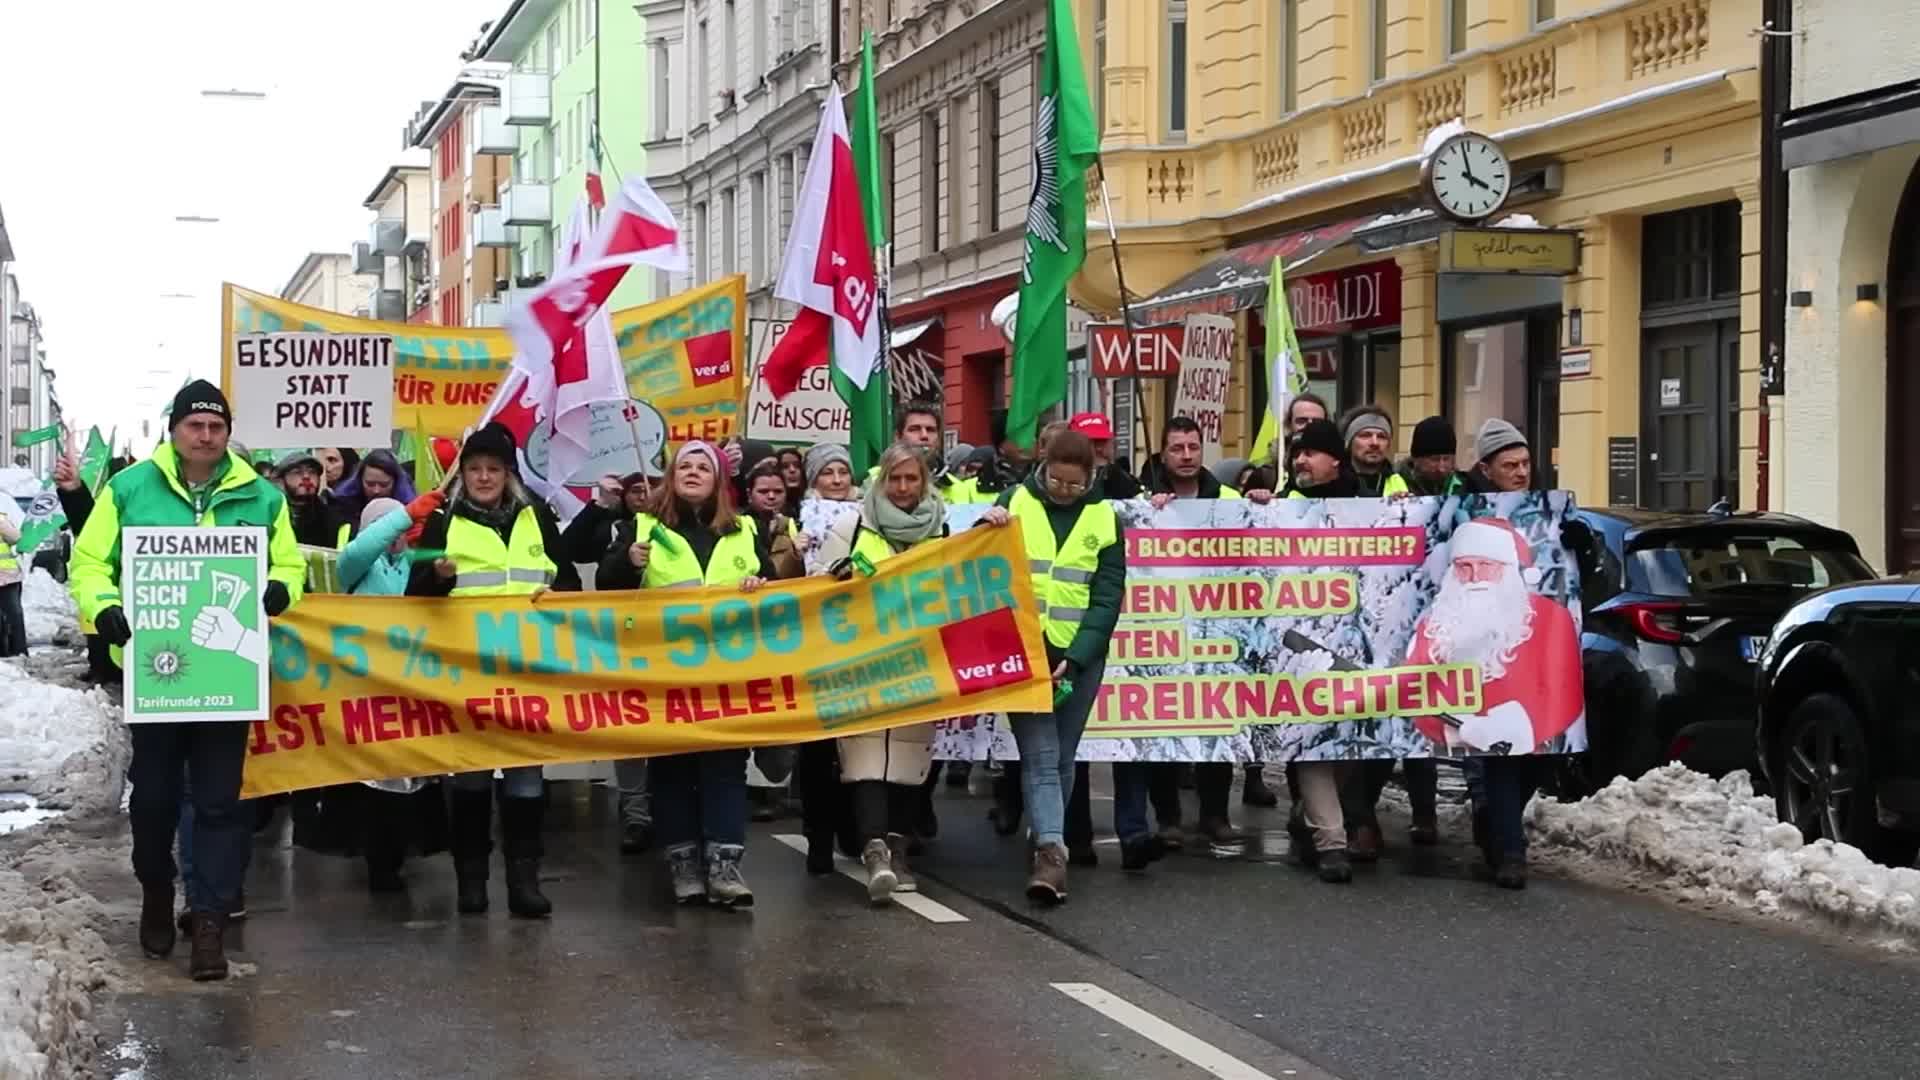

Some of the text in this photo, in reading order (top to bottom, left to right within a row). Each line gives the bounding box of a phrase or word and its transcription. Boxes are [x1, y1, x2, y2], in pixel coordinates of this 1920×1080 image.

[238, 337, 392, 368] GESUNDHEIT
[1095, 334, 1181, 371] WEIN
[286, 374, 349, 396] STATT
[394, 375, 498, 406] ÜR UNS
[275, 401, 373, 429] PROFITE
[136, 535, 258, 555] ZUSAMMEN
[1138, 537, 1291, 558] BLOCKIEREN
[1300, 535, 1417, 557] WEITER!?
[135, 561, 204, 582] ZAHLT
[135, 585, 187, 606] SICH
[1188, 581, 1266, 612] WIR
[1275, 578, 1350, 610] AUS
[135, 609, 181, 631] AUS
[473, 606, 649, 675] MIN.
[820, 592, 859, 645] €
[871, 554, 1017, 636] MEHR
[958, 654, 1024, 682] ver di
[137, 694, 234, 709] Tarifrunde 2023
[250, 674, 798, 756] IST MEHR FÜR UNS ALLE!
